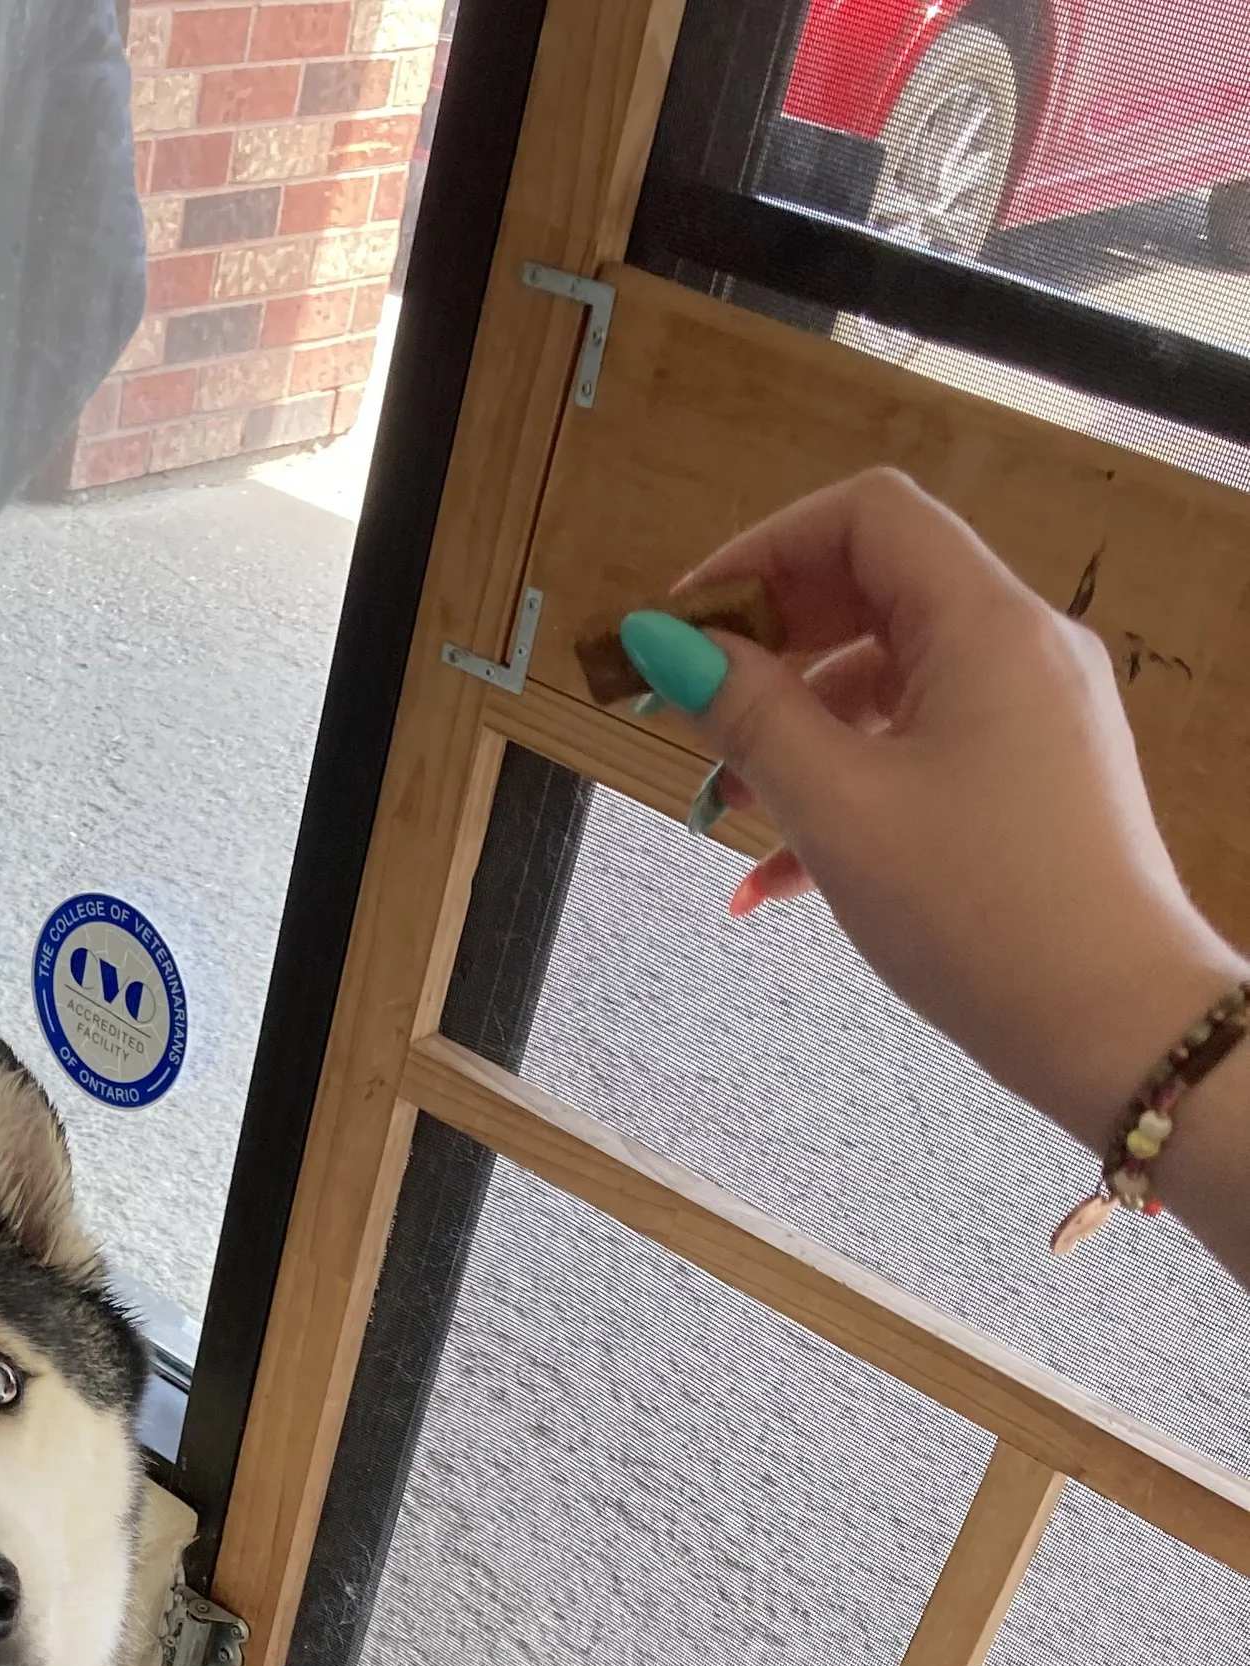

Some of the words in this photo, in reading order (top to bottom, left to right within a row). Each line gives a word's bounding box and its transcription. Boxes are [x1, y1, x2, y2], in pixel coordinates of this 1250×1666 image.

[38, 942, 55, 977] THE
[49, 901, 106, 942] COLLEGE
[110, 904, 131, 922] OF
[134, 917, 186, 1066] VETERINARIANS
[67, 999, 145, 1054] ACCREDITED
[76, 1023, 130, 1062] FACILITY
[59, 1046, 78, 1067] OF
[79, 1069, 140, 1103] ONTARIO
